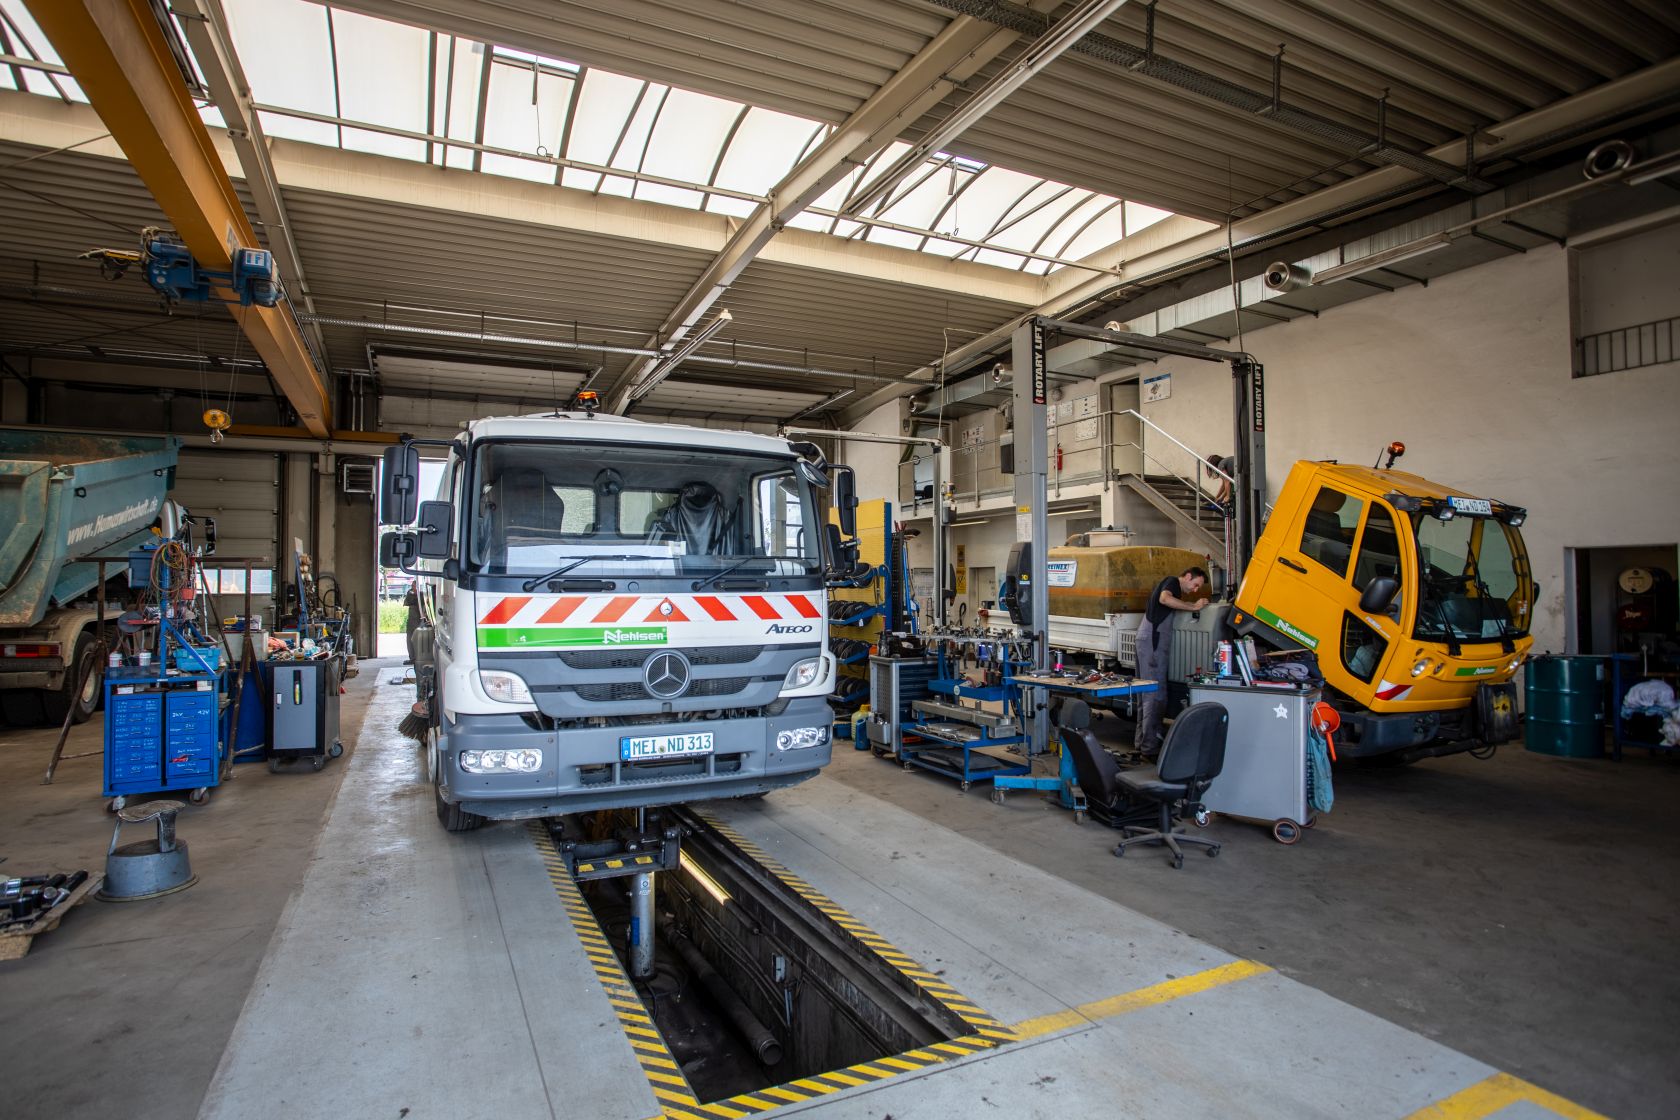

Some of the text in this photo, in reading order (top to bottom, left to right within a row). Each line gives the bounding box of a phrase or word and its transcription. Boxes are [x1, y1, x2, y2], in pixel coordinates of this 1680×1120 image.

[1035, 326, 1044, 397] ROTARY LIFT
[1255, 388, 1263, 425] ROTARY
[602, 628, 664, 645] Nehlsen
[1276, 619, 1317, 647] Nehlsen
[632, 735, 711, 756] MEI ND 313
